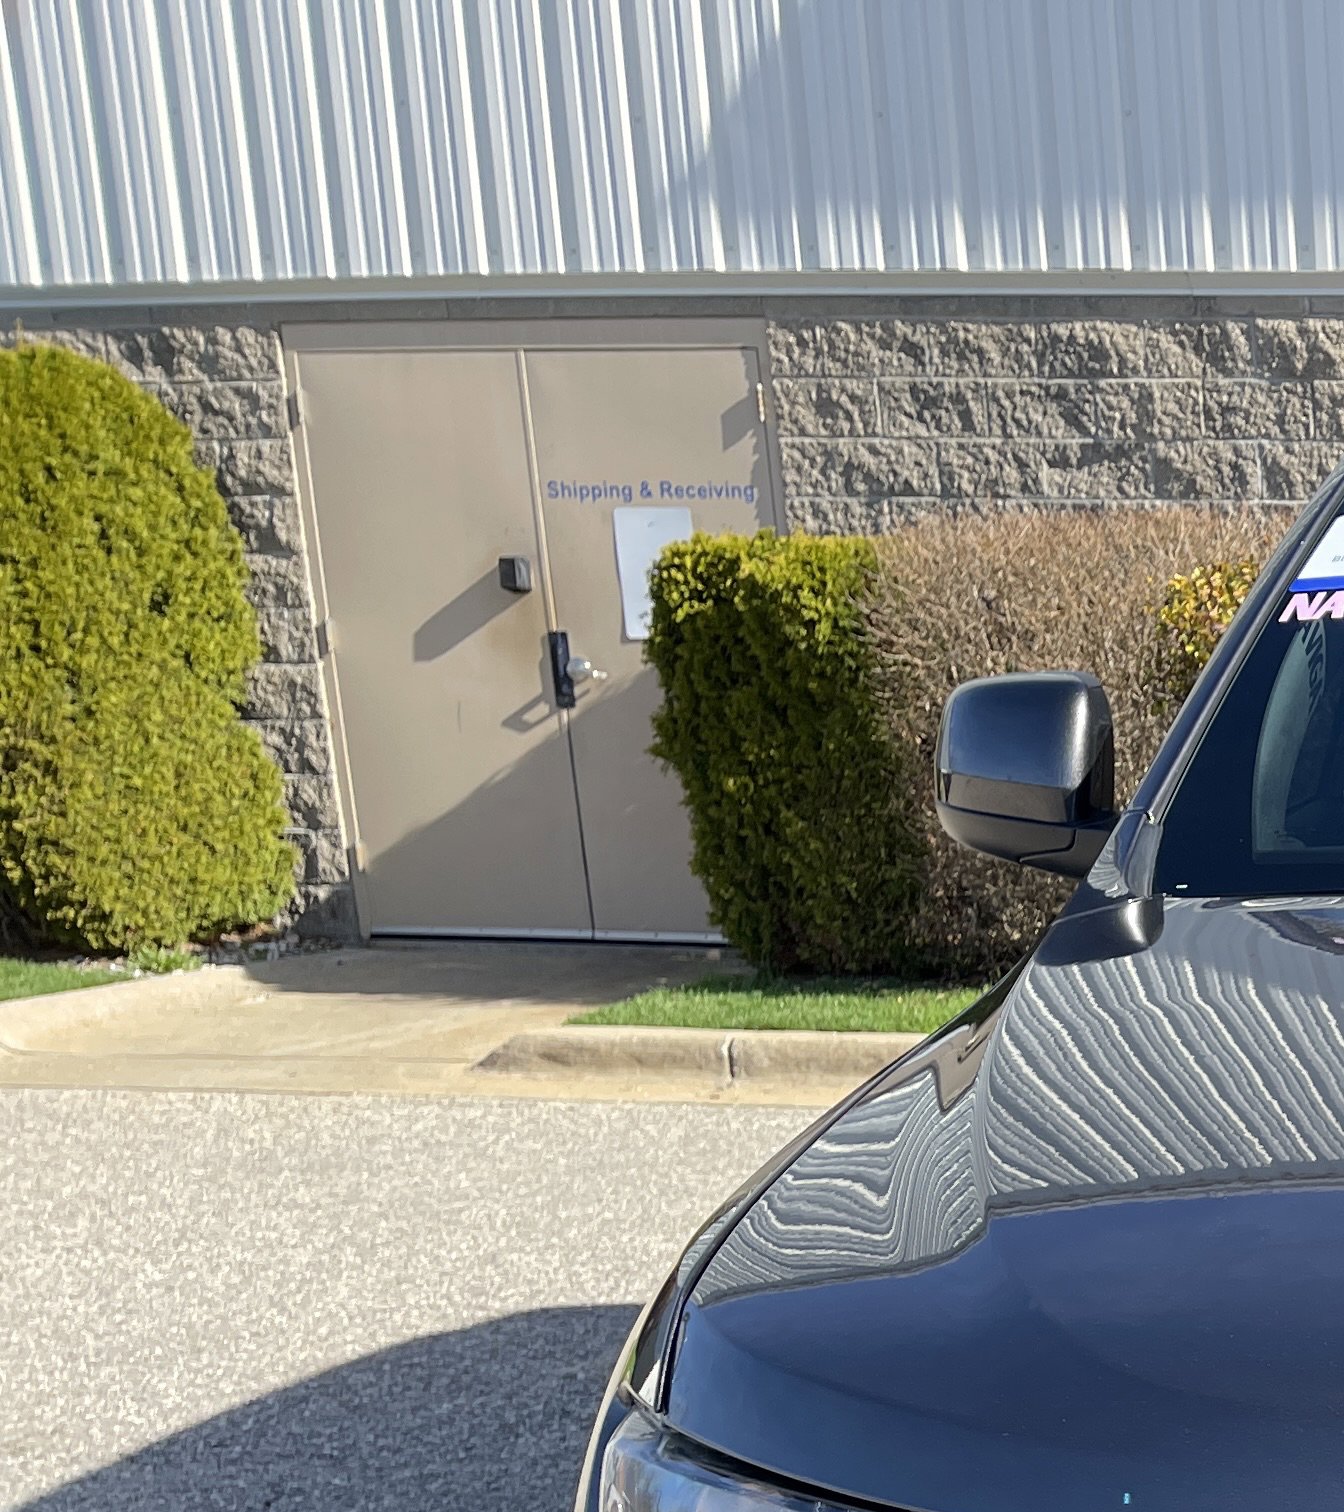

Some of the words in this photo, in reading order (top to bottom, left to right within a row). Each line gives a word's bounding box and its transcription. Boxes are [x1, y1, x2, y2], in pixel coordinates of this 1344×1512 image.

[547, 480, 632, 502] Shipping
[639, 480, 652, 498] &
[659, 480, 755, 503] Receiving
